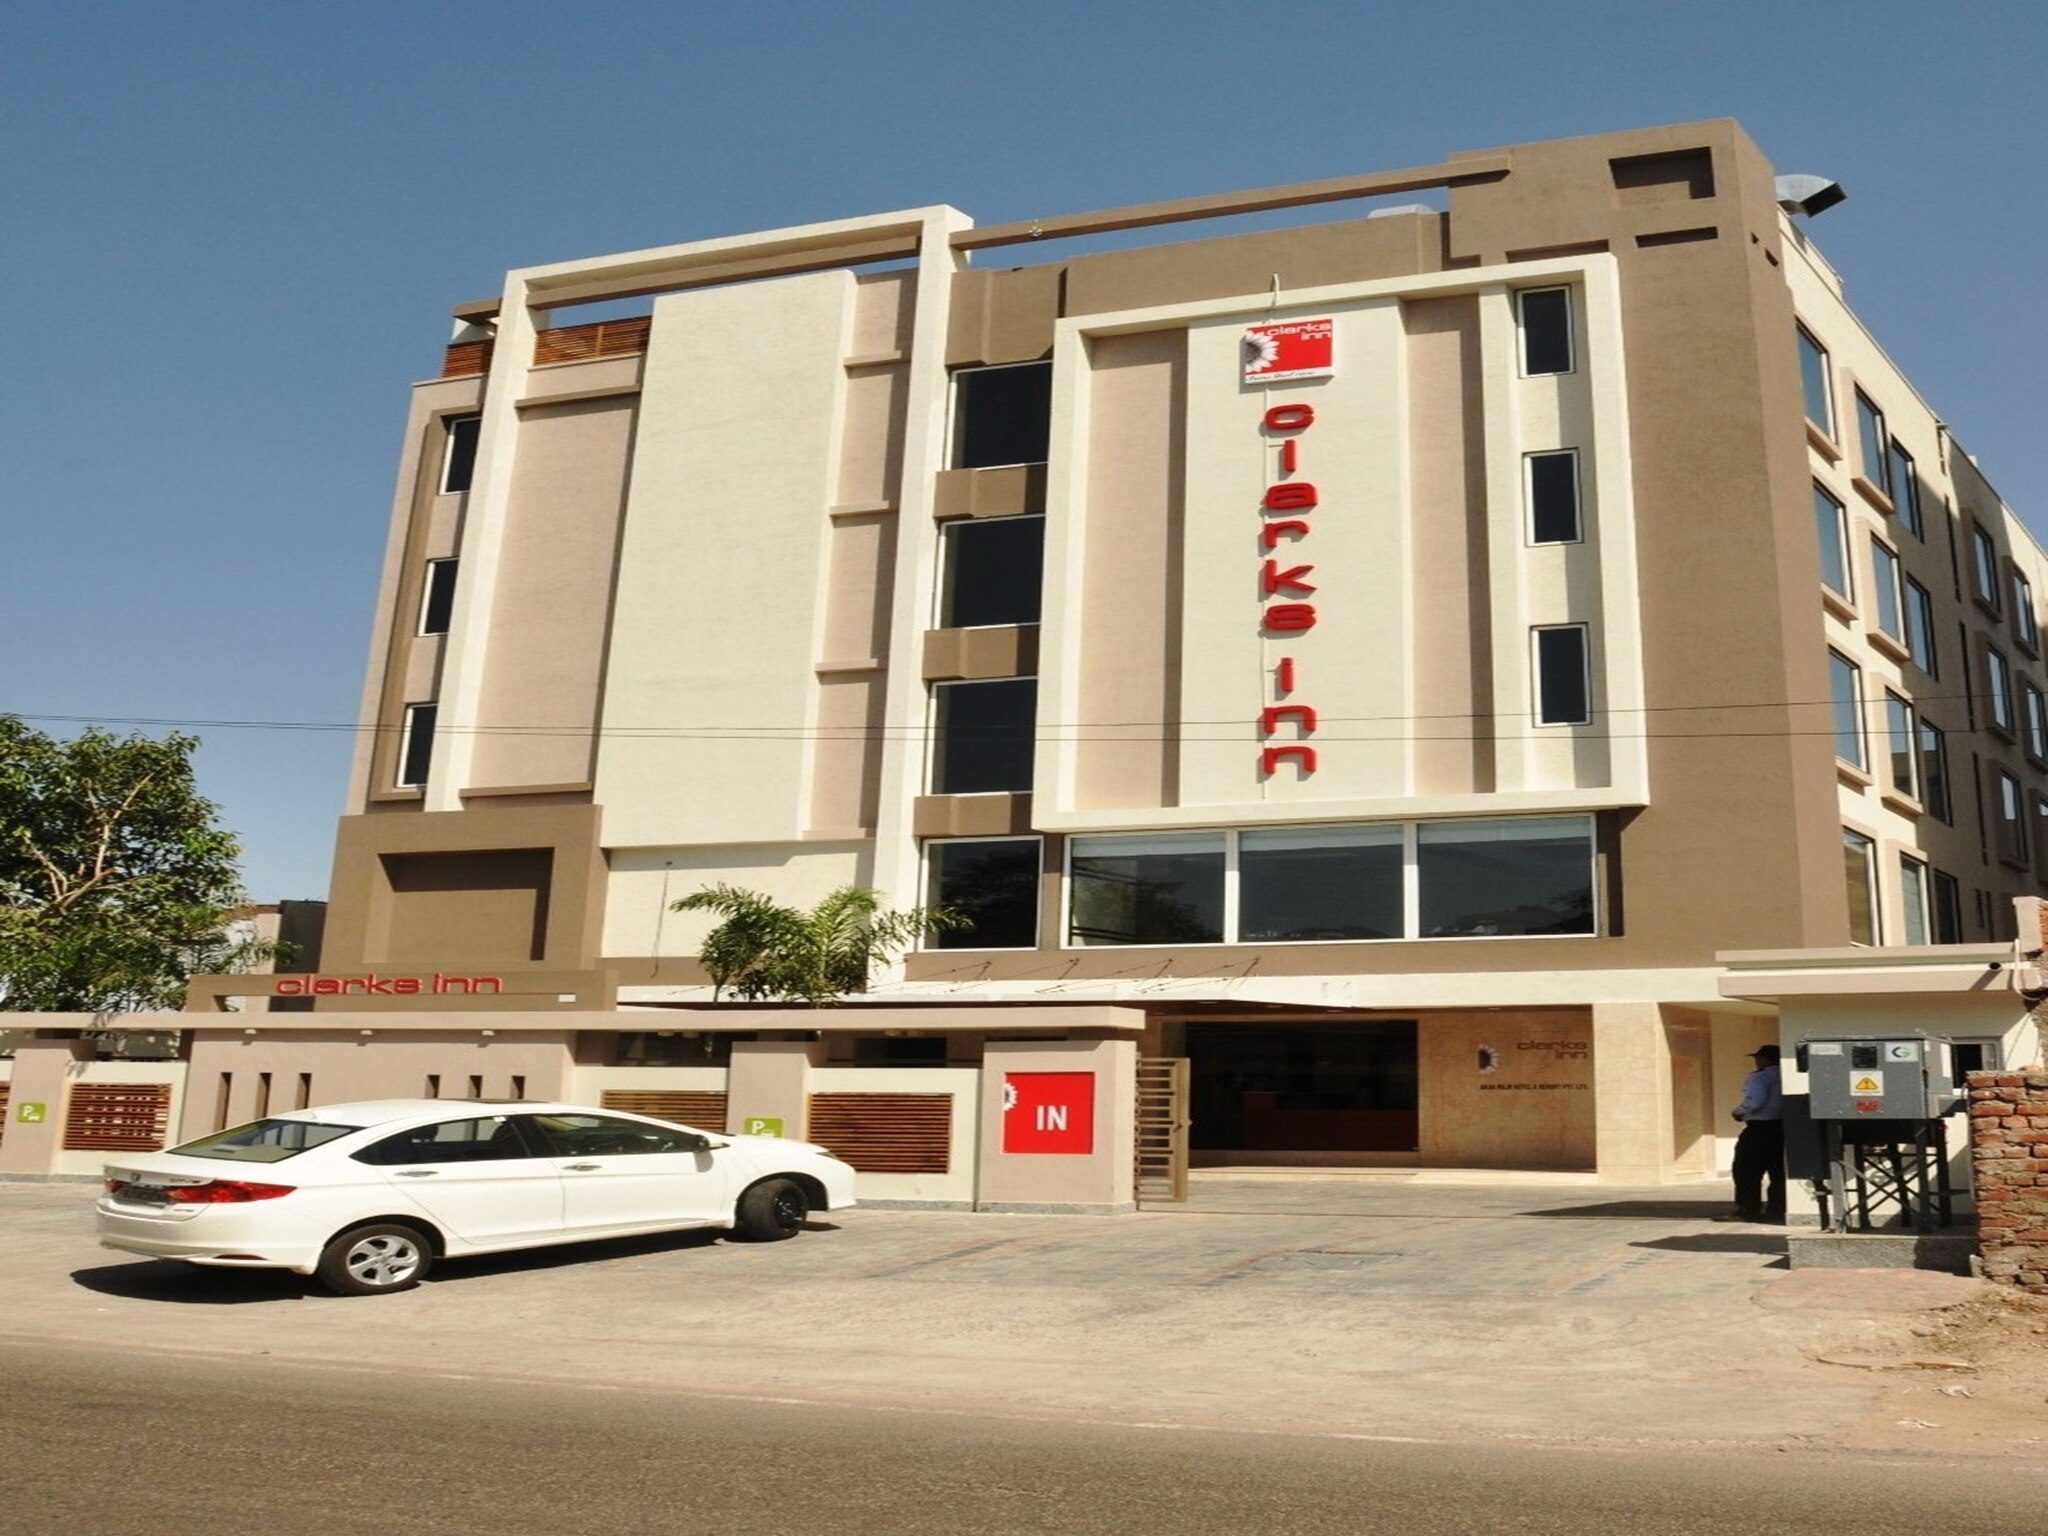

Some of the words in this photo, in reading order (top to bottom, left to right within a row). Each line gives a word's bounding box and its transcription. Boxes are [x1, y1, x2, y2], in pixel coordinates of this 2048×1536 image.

[1267, 323, 1331, 336] clarks
[1301, 331, 1331, 341] inn
[1264, 403, 1318, 631] clarks
[1263, 657, 1317, 775] inn
[275, 974, 423, 995] clarks
[433, 973, 503, 994] inn
[1517, 1040, 1588, 1051] clarks
[23, 1105, 34, 1117] P
[1036, 1105, 1068, 1131] IN
[752, 1120, 765, 1135] P
